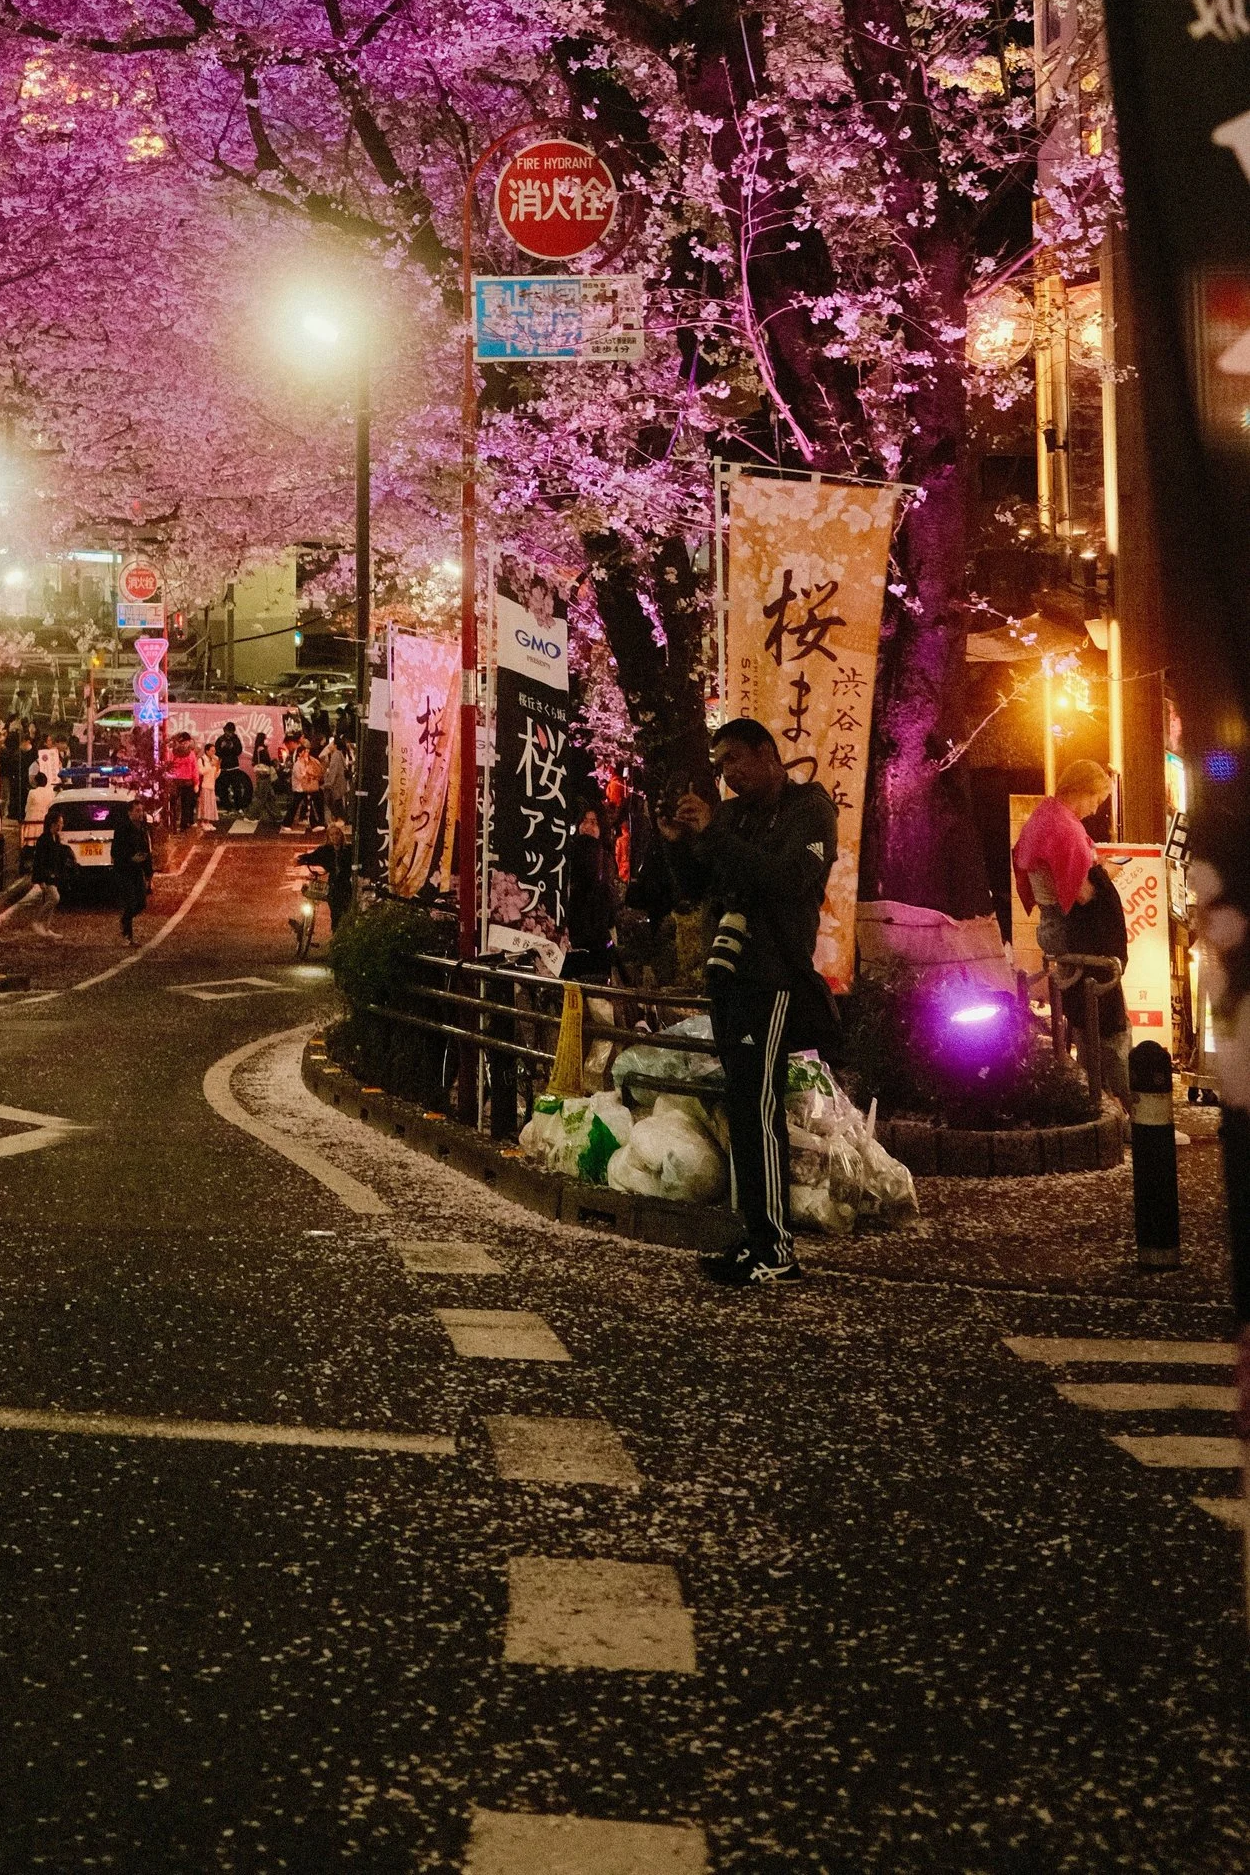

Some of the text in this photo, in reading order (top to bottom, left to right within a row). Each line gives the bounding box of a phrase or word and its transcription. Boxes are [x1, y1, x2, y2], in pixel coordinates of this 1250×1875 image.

[516, 157, 594, 169] FIRE HYDRANT
[508, 177, 607, 222] 消火栓
[127, 575, 155, 590] 消火栓
[515, 628, 562, 660] GMO
[740, 657, 751, 719] SAKU
[762, 568, 848, 783] 桜まつ
[827, 666, 869, 810] 渋谷桜丘
[398, 747, 409, 807] SAKURA
[517, 805, 547, 914] アップ
